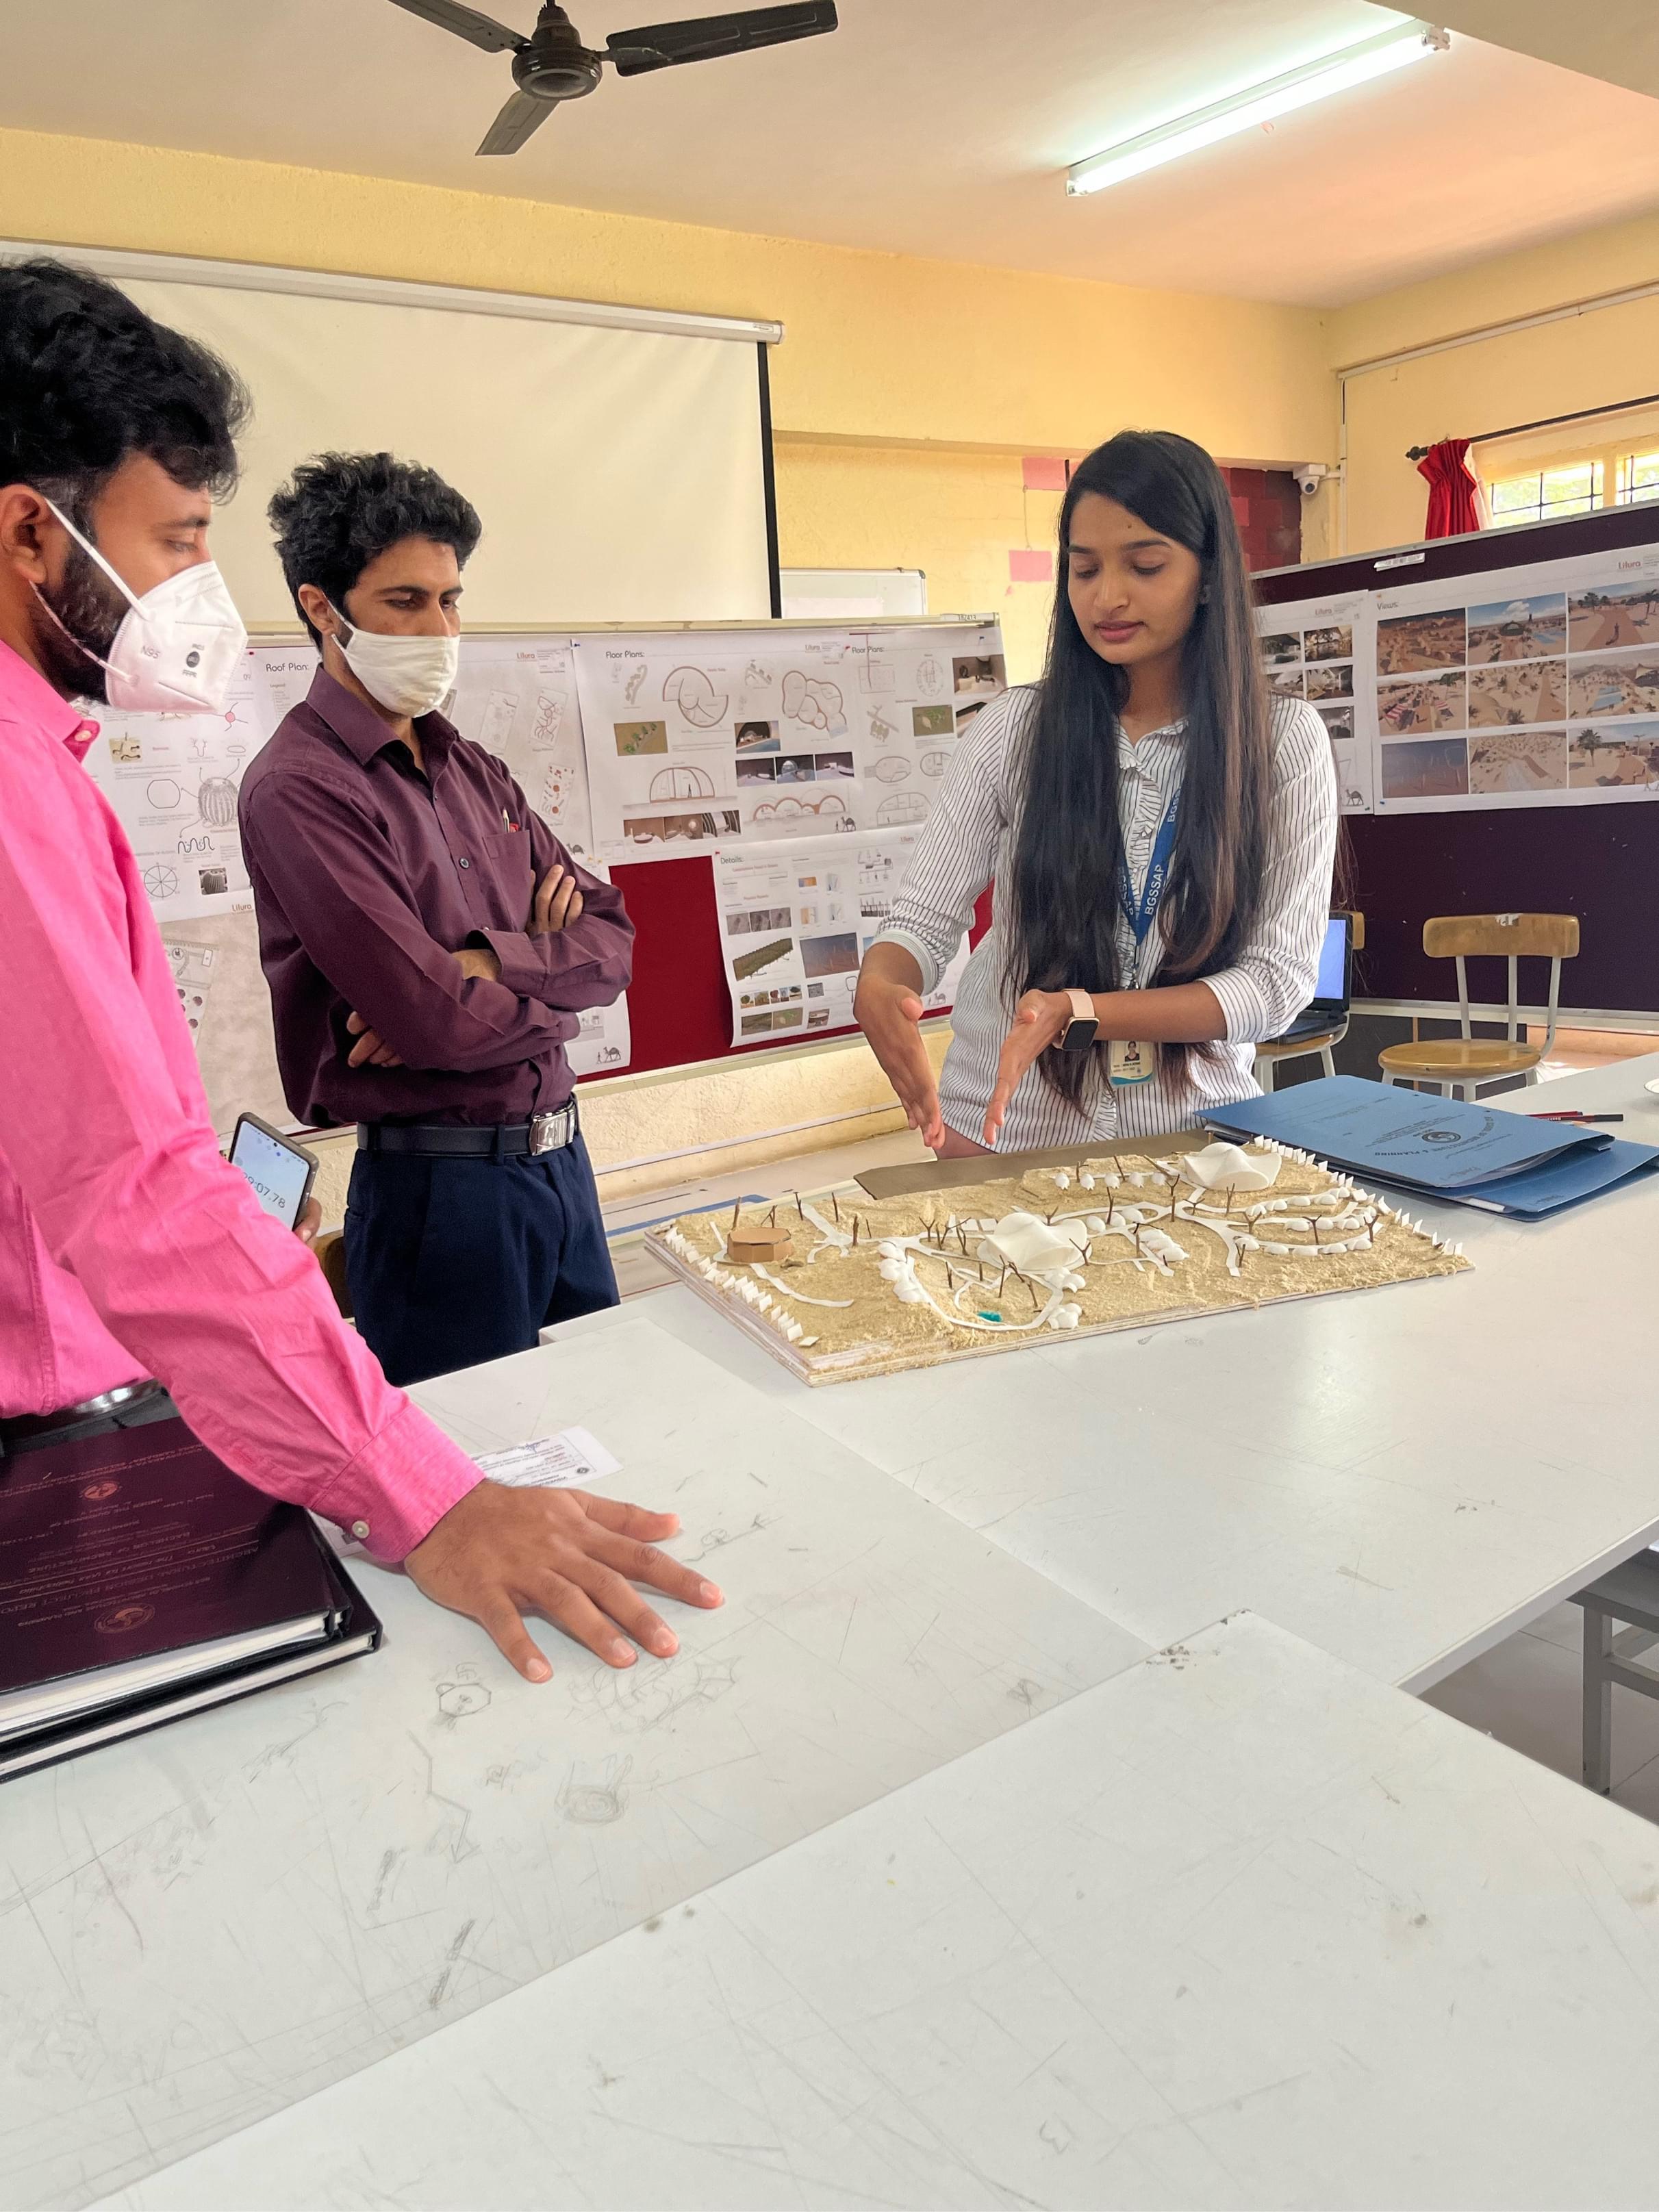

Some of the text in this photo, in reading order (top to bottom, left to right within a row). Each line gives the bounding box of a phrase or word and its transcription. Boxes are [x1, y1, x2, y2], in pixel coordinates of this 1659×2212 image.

[141, 646, 161, 659] N95
[266, 662, 309, 672] Roof Plan:
[1144, 864, 1165, 915] BGSSAP
